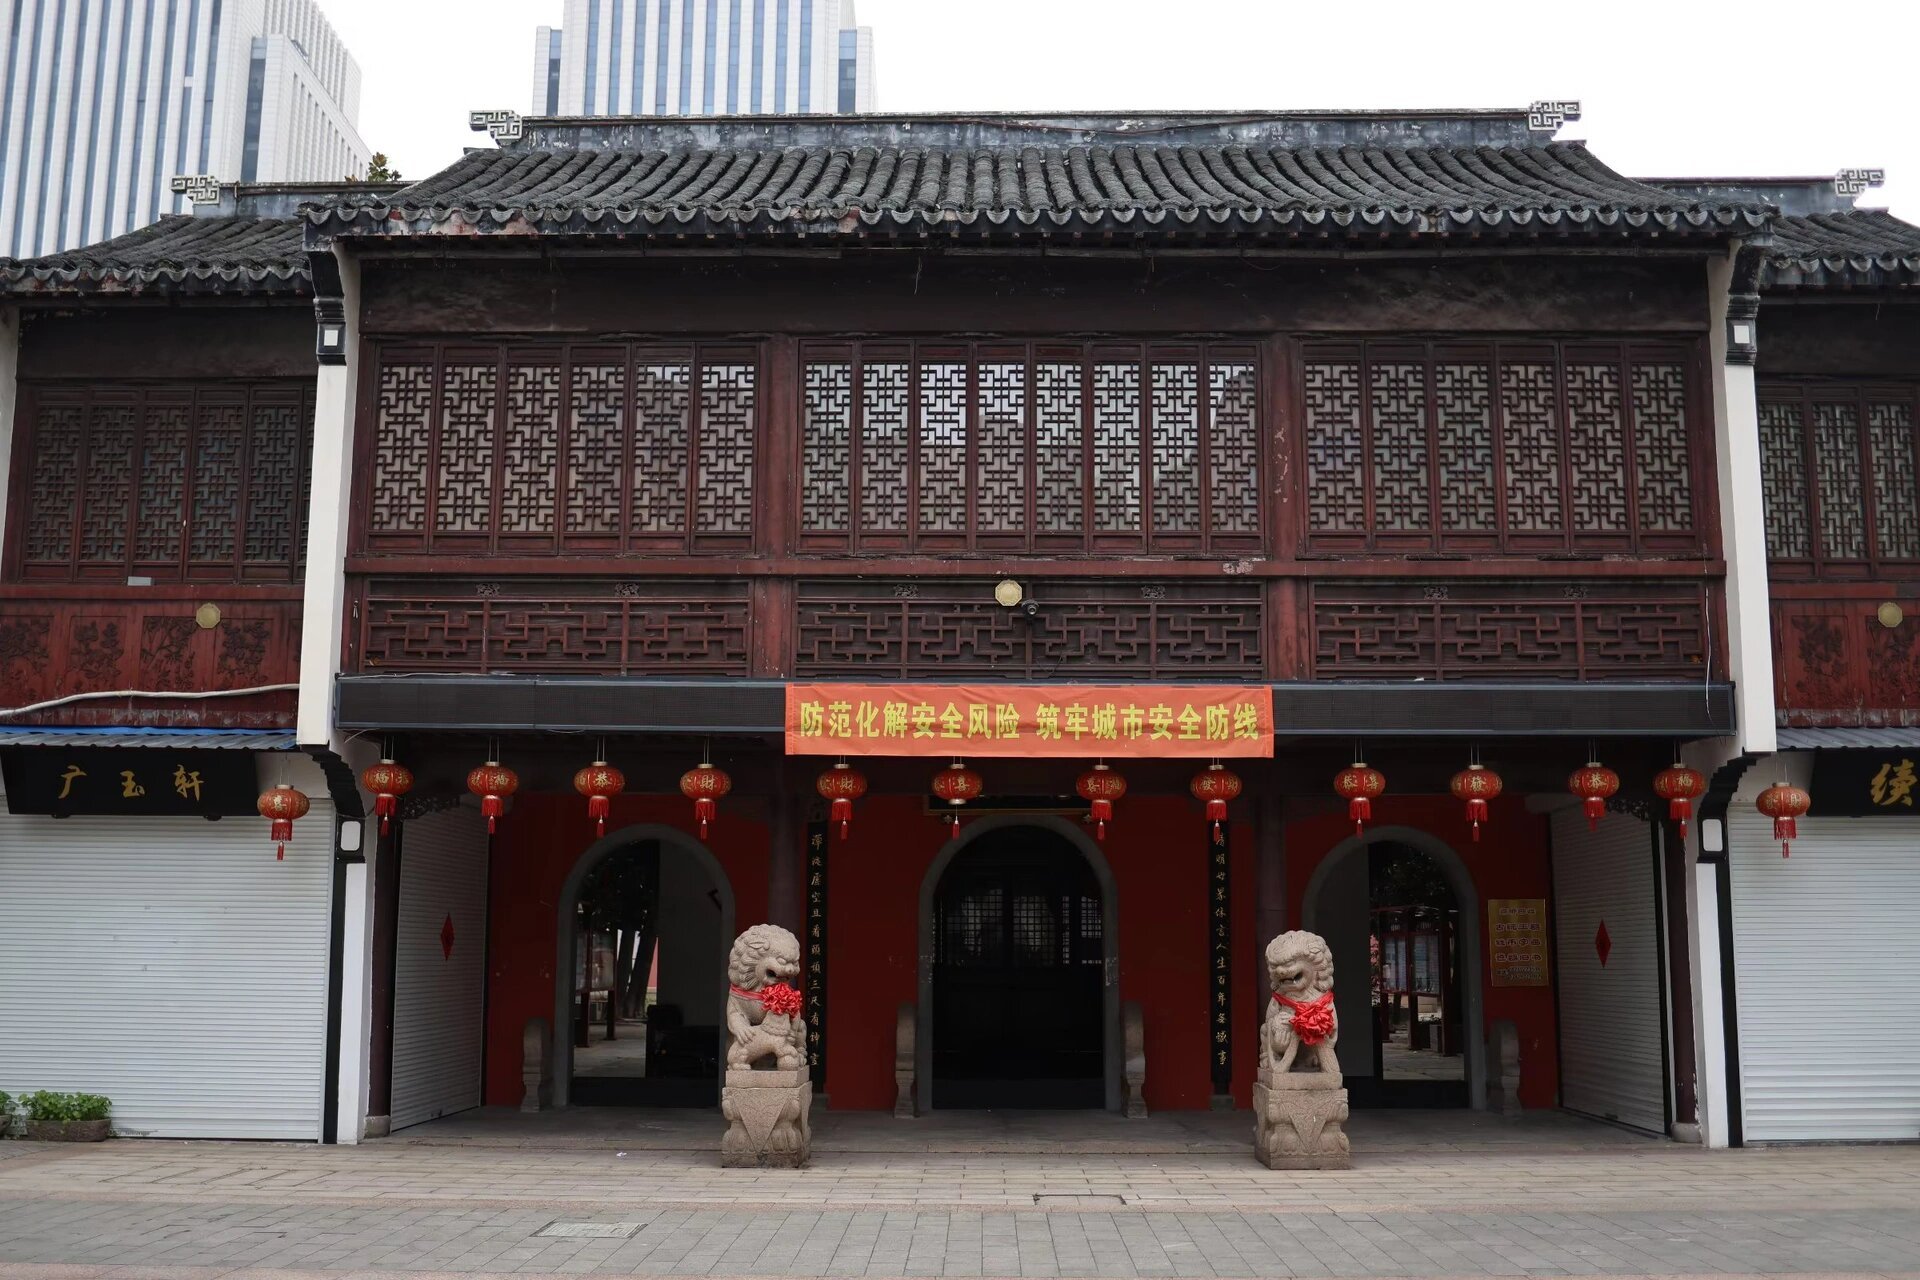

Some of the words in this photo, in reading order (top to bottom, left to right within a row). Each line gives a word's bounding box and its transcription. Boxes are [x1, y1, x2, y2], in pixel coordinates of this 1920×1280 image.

[800, 701, 1020, 739] 防范化解安全风险
[1036, 703, 1259, 740] 筑牢城市安全防线
[58, 765, 204, 801] 广玉轩
